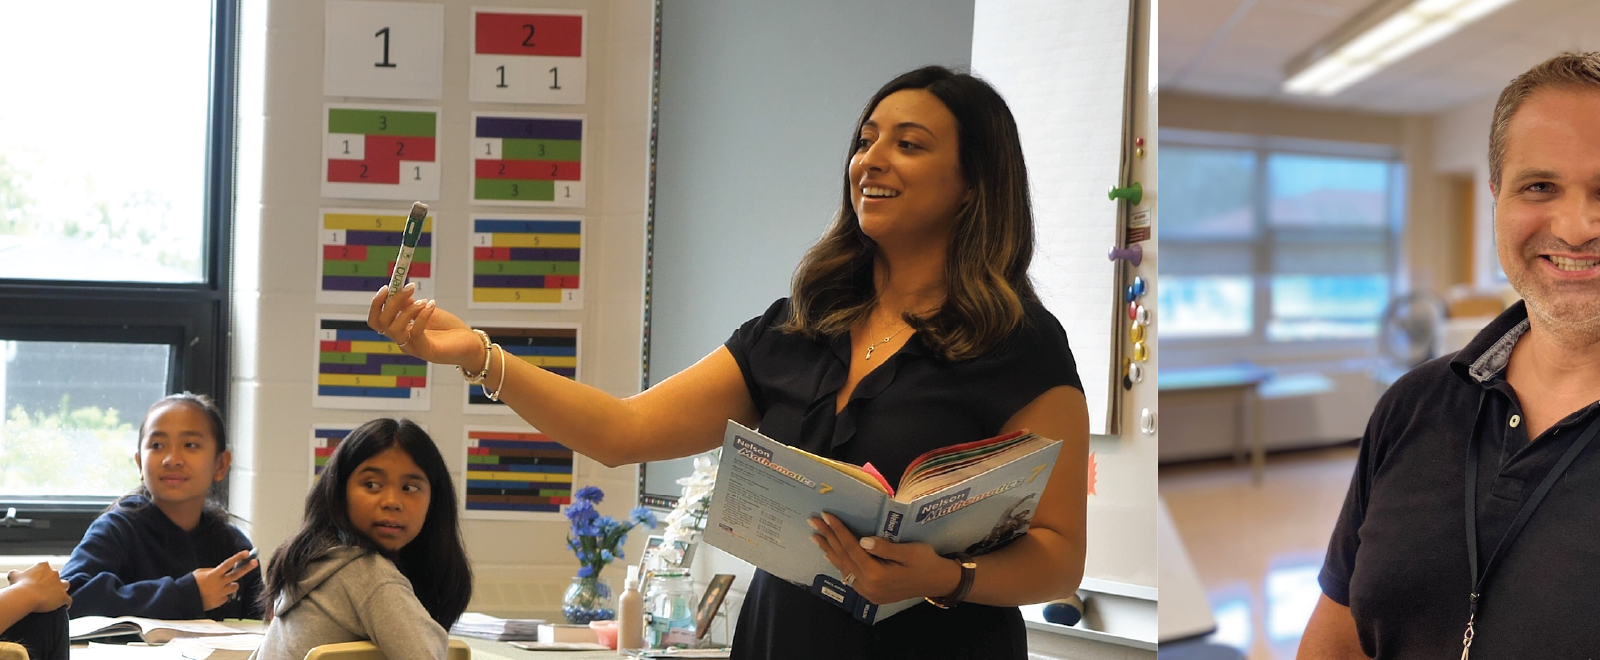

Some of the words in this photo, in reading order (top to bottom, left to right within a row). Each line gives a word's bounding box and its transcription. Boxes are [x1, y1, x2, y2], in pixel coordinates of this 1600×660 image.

[521, 24, 536, 48] 2
[374, 26, 397, 68] 1
[495, 65, 508, 89] 1
[549, 66, 562, 90] 1
[378, 115, 387, 131] 3
[342, 139, 351, 154] 1
[396, 141, 405, 157] 2
[484, 142, 492, 156] 1
[538, 143, 546, 157] 3
[359, 164, 369, 179] 2
[413, 165, 422, 181] 1
[498, 163, 506, 175] 2
[550, 164, 558, 177] 2
[510, 184, 519, 197] 3
[564, 185, 571, 198] 1
[375, 218, 382, 228] 5
[332, 232, 338, 242] 1
[481, 236, 486, 245] 1
[534, 236, 540, 245] 5
[342, 247, 349, 258] 2
[489, 249, 495, 258] 2
[352, 263, 360, 274] 3
[417, 281, 422, 291] 1
[514, 290, 521, 301] 5
[568, 292, 573, 301] 1
[527, 337, 534, 345] 7
[736, 437, 771, 459] Nelson
[737, 447, 817, 489] Mathematics
[819, 482, 834, 495] 7
[921, 477, 1025, 526] Mathematics
[1028, 463, 1048, 484] 7
[921, 492, 966, 515] Nelson
[886, 512, 900, 533] Nelson
